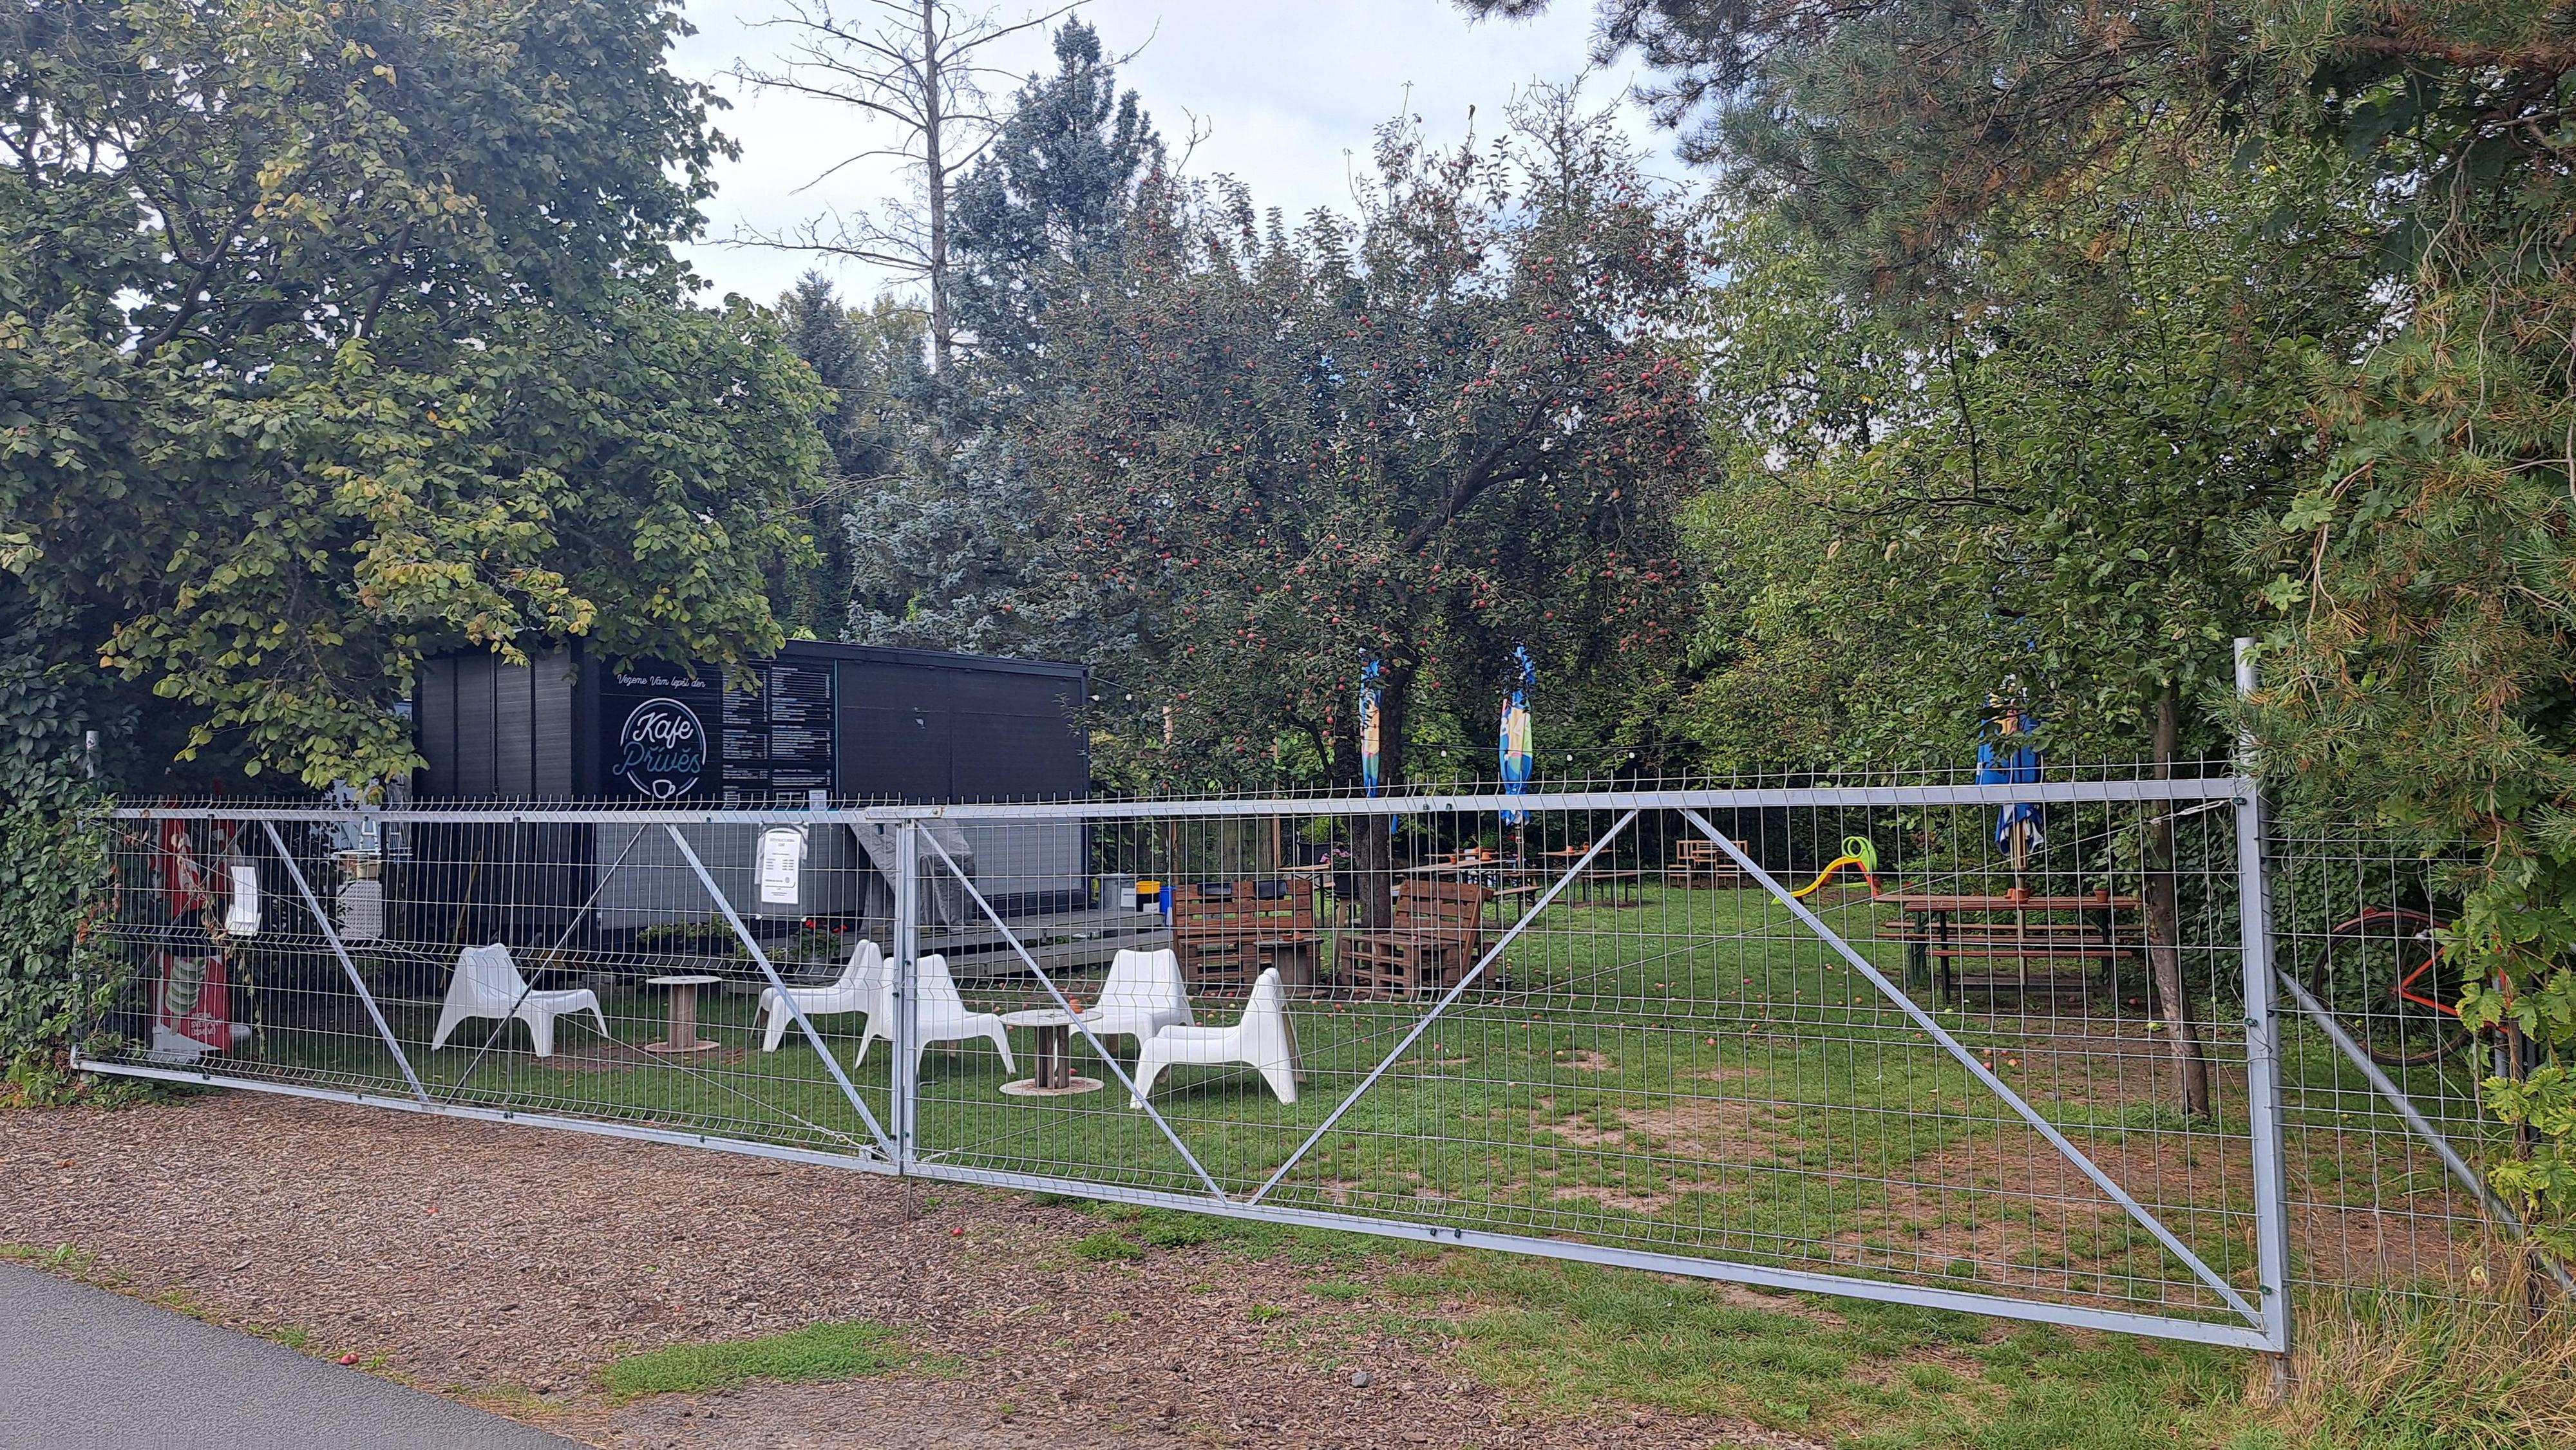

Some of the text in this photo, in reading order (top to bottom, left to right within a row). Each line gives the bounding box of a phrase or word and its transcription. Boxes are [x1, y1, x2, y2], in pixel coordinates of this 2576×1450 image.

[617, 673, 648, 687] Vezeme
[670, 675, 690, 690] lepší
[691, 677, 706, 688] den
[632, 711, 694, 749] Kafe
[612, 740, 701, 776] Přívěs
